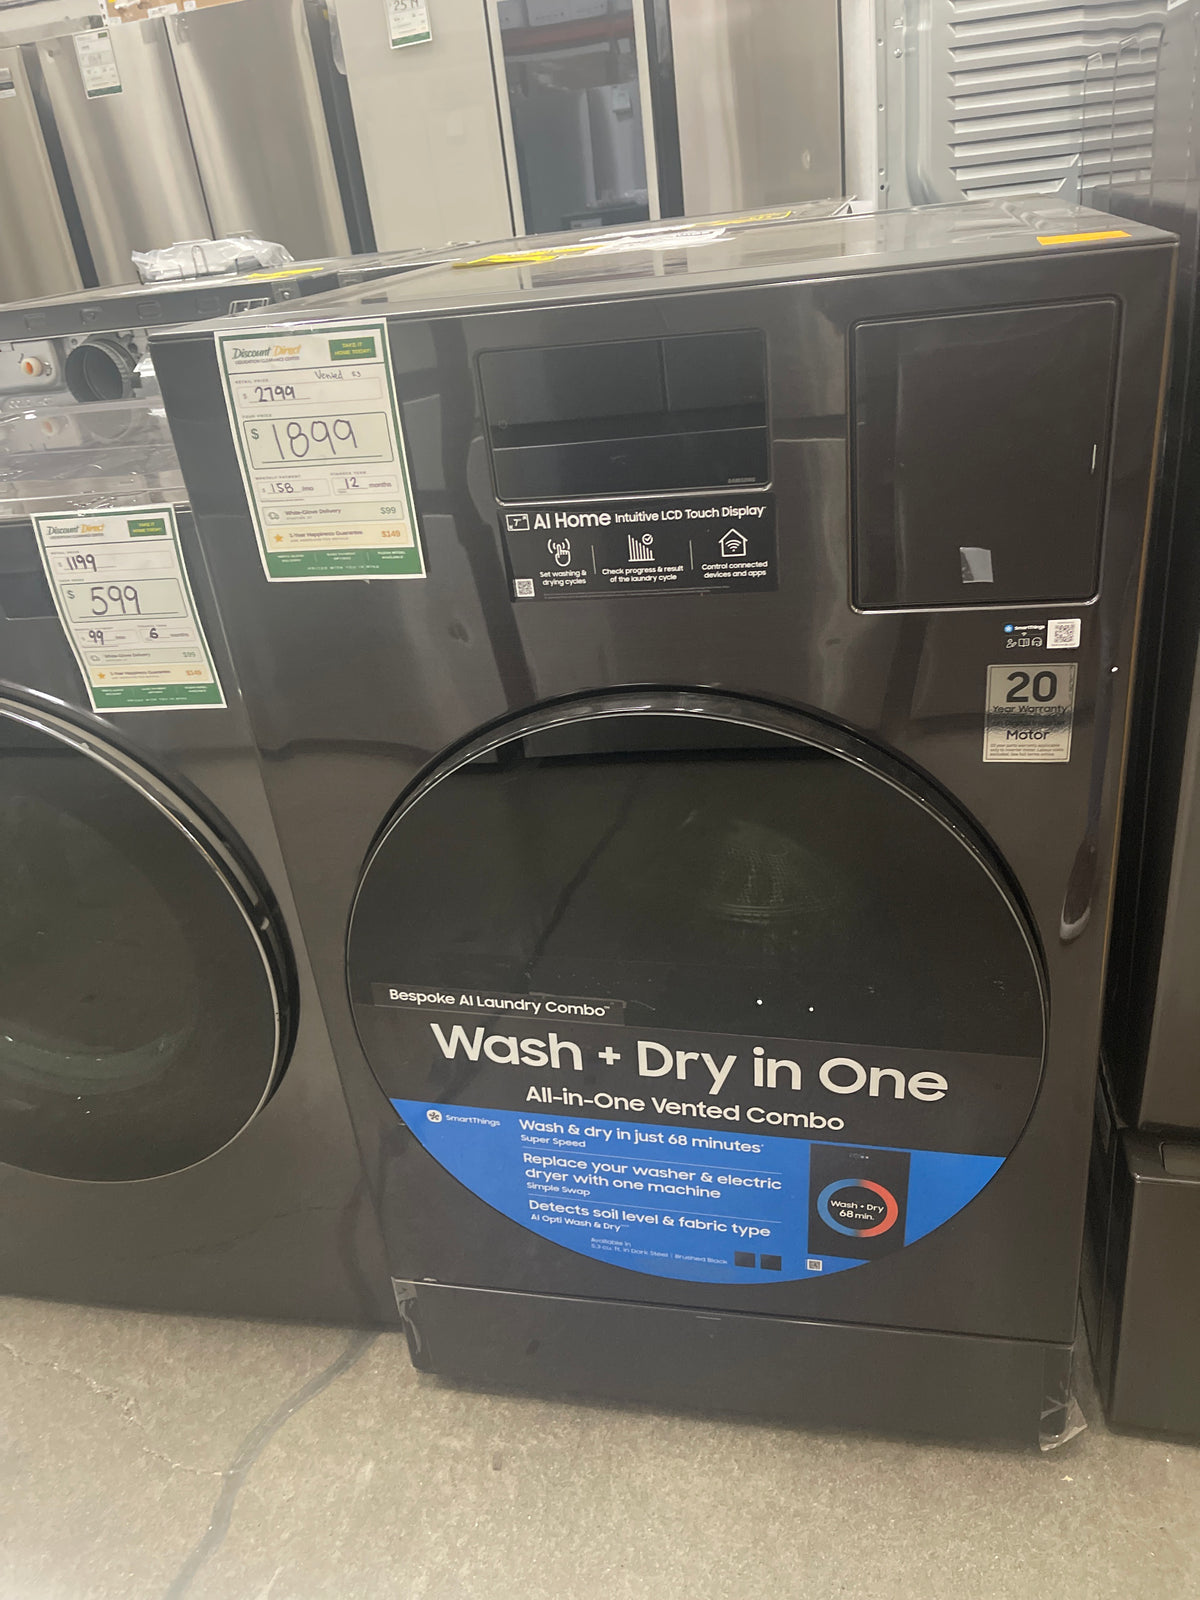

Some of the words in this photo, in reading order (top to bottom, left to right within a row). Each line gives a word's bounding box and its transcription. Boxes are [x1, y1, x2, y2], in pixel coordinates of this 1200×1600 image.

[232, 346, 272, 360] Discount
[273, 344, 302, 356] Direct
[255, 386, 295, 402] 2799
[250, 428, 260, 440] $
[272, 419, 358, 460] 1899
[271, 482, 294, 493] 158
[344, 477, 359, 489] 12
[380, 507, 397, 515] $99
[534, 513, 551, 530] AI
[554, 512, 612, 528] Home
[615, 511, 659, 523] Intuitive
[661, 510, 683, 521] LCD
[685, 508, 719, 519] Touch
[46, 526, 79, 535] Discount
[66, 554, 97, 572] 1199
[729, 561, 768, 569] connected
[625, 567, 656, 576] progress
[631, 574, 657, 583] laundry
[658, 574, 677, 582] cycle
[747, 569, 767, 578] apps
[565, 578, 587, 586] cycles
[67, 590, 75, 599] $
[91, 586, 141, 615] 599
[89, 630, 104, 645] 99
[150, 628, 158, 639] 6
[1006, 670, 1058, 703] 20
[1018, 705, 1067, 714] Warranty
[1006, 730, 1050, 740] Motor
[389, 989, 455, 1005] Bespoke
[460, 994, 473, 1006] AI
[477, 996, 541, 1015] Laundry
[430, 1022, 584, 1070] Wash
[598, 1046, 621, 1065] +
[637, 1040, 737, 1095] Dry
[753, 1046, 802, 1091] in
[818, 1057, 948, 1102] One
[526, 1086, 646, 1112] All-in-One
[650, 1097, 740, 1121] Vented
[745, 1106, 845, 1131] Combo
[446, 1113, 500, 1127] SmartThings
[518, 1119, 564, 1134] Wash
[568, 1124, 580, 1135] &
[584, 1126, 612, 1142] dry
[616, 1128, 631, 1140] in
[633, 1130, 664, 1144] just
[668, 1134, 688, 1146] 68
[520, 1134, 550, 1144] Super
[553, 1138, 586, 1148] Speed
[523, 1153, 588, 1169] Replace
[591, 1161, 628, 1174] your
[632, 1166, 696, 1180] washer
[700, 1172, 713, 1183] &
[717, 1174, 782, 1190] electric
[525, 1168, 568, 1182] dryer
[573, 1174, 609, 1187] with
[613, 1179, 644, 1190] one
[648, 1182, 721, 1199] machine
[526, 1182, 560, 1192] Simple
[561, 1186, 590, 1197] Swap
[830, 1200, 857, 1209] Wash
[866, 1204, 884, 1213] Dry
[529, 1200, 590, 1216] Detects
[593, 1208, 619, 1220] soil
[622, 1210, 658, 1224] level
[662, 1216, 675, 1227] &
[678, 1216, 727, 1233] fabric
[731, 1223, 771, 1238] type
[541, 1214, 562, 1224] Opti
[564, 1217, 592, 1228] Wash
[840, 1210, 853, 1218] 68
[591, 1237, 623, 1246] Available
[675, 1254, 706, 1262] Brushed
